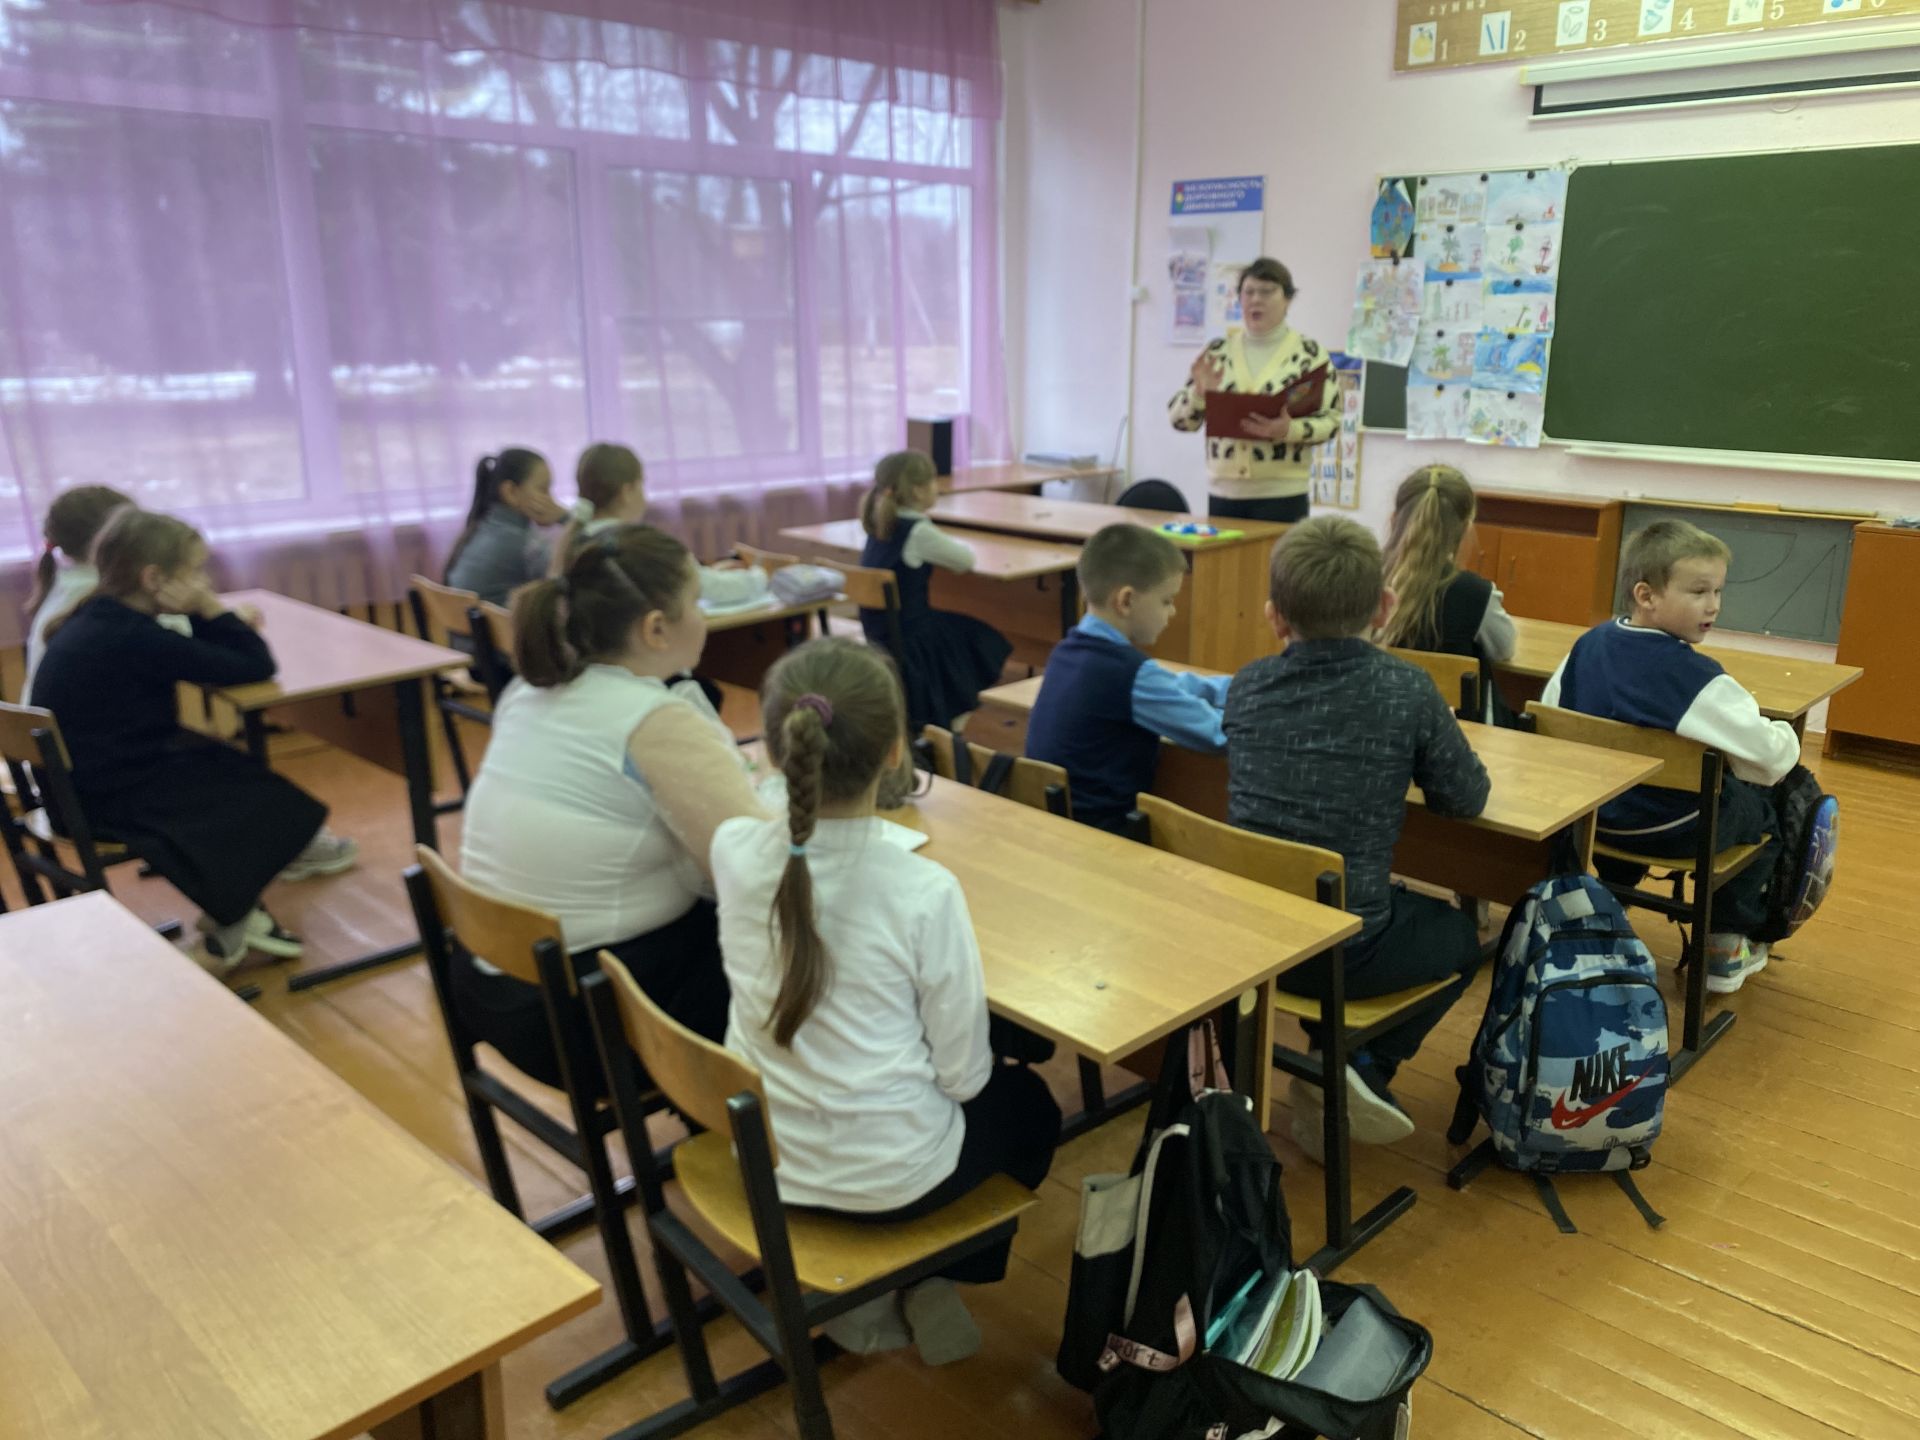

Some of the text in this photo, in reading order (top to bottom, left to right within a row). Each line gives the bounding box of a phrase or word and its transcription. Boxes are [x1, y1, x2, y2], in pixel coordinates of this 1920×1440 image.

[1441, 0, 1785, 61] 1 2 3 4 5
[1569, 1042, 1637, 1102] NIKE
